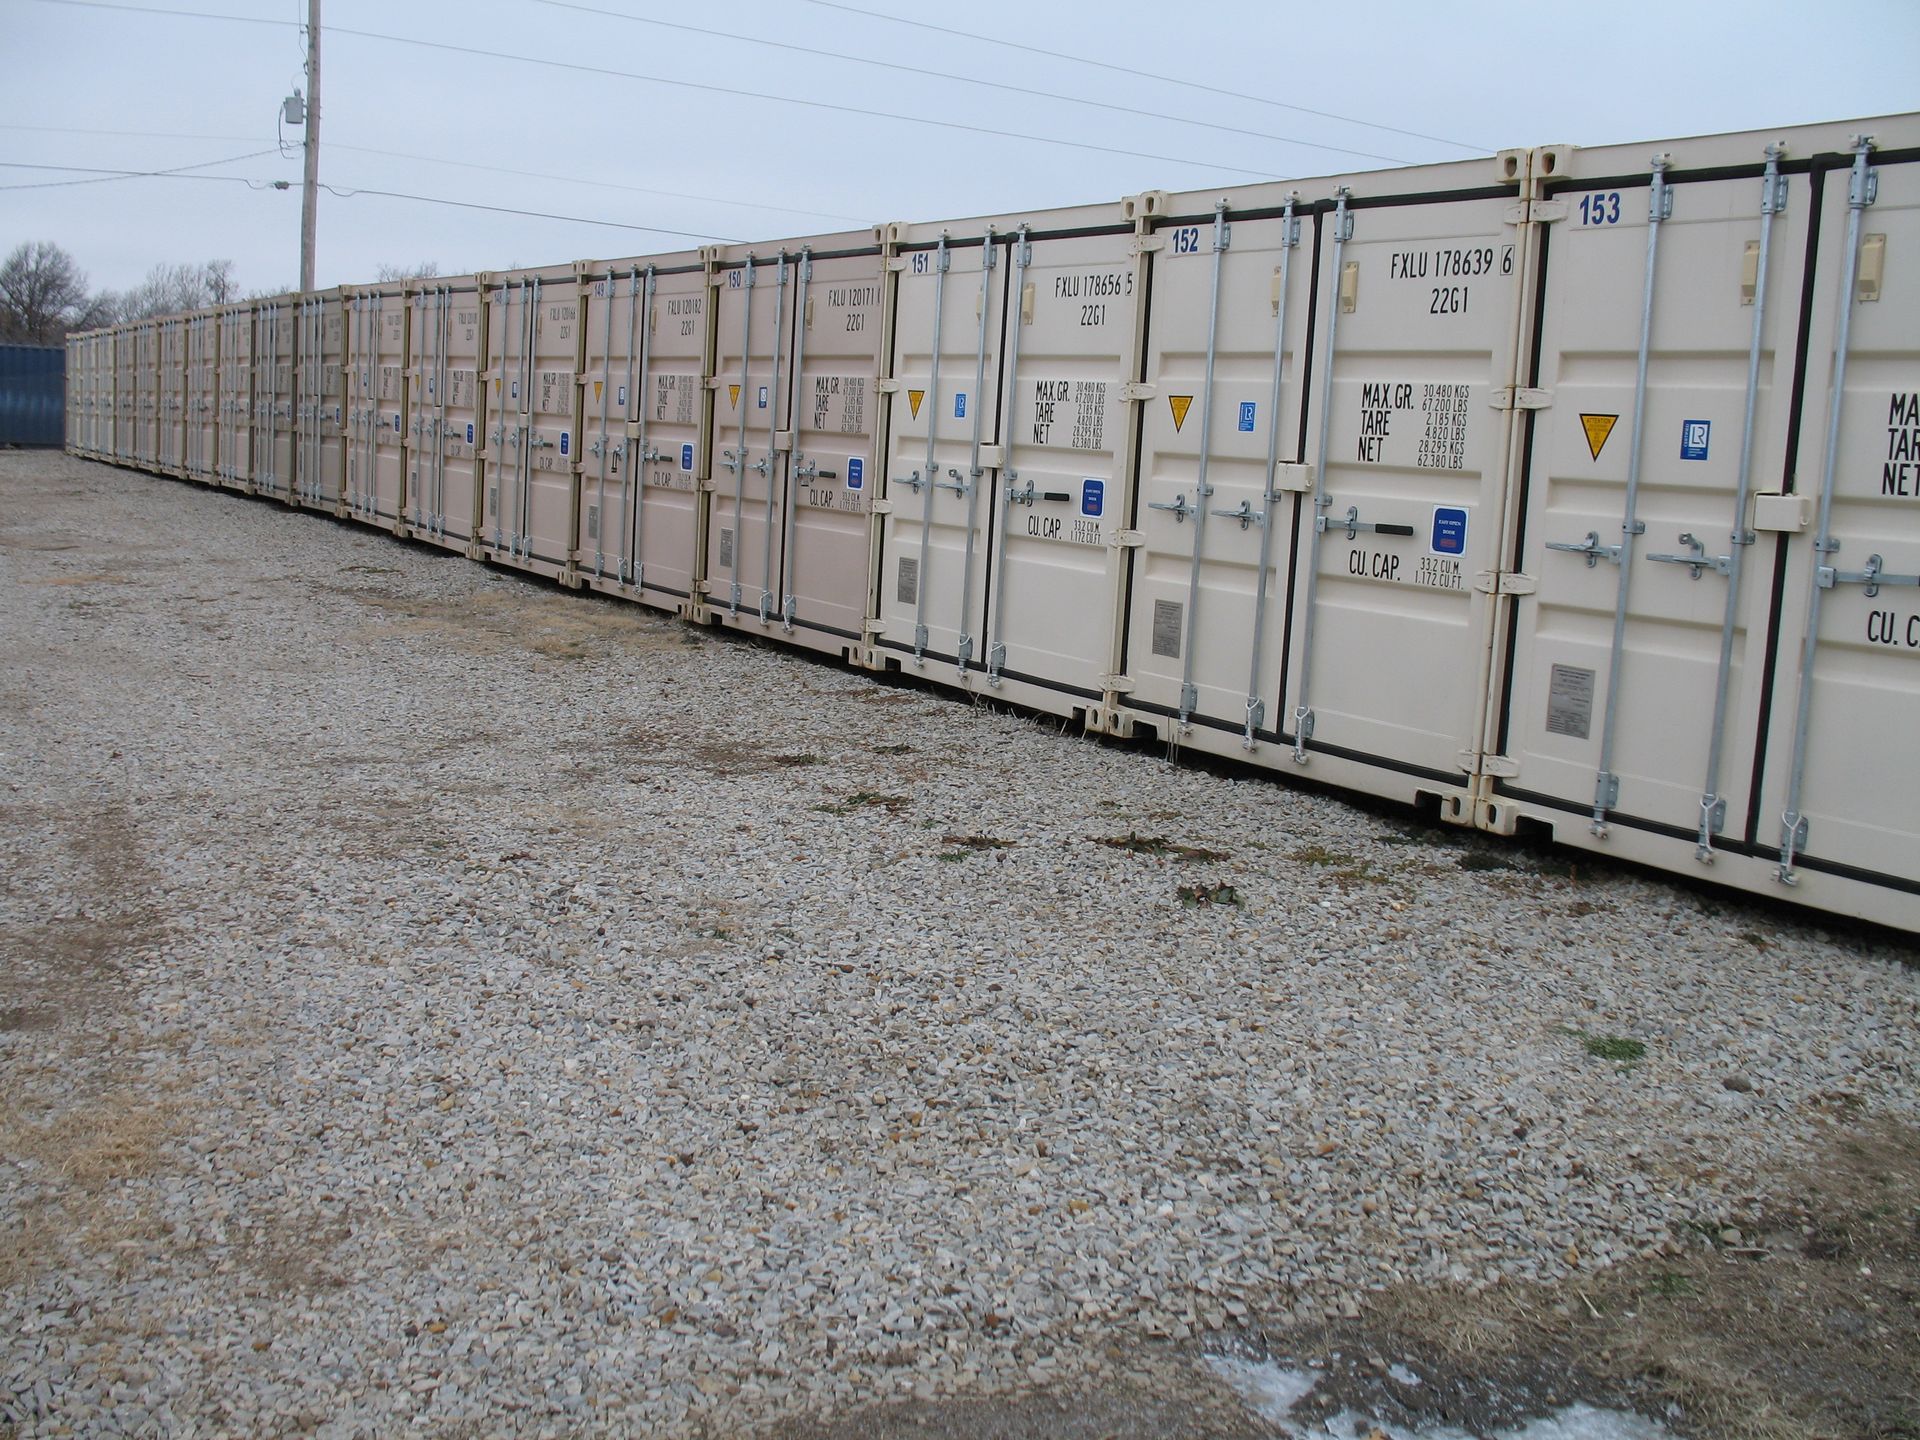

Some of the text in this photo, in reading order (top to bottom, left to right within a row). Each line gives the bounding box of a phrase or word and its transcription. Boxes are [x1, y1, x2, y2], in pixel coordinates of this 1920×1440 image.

[1580, 192, 1620, 225] 153
[1172, 228, 1198, 253] 152
[912, 254, 928, 273] 151
[1390, 247, 1512, 278] FXLU 178639 6
[729, 271, 741, 288] 150
[1055, 276, 1080, 297] FXLU
[1084, 274, 1121, 296] 178656
[828, 289, 845, 307] FXLU
[849, 288, 874, 306] 120171
[1430, 286, 1468, 314] 22G1
[846, 314, 864, 331] 22G1
[1081, 304, 1105, 326] 22G1
[1096, 382, 1106, 393] KGS
[1424, 385, 1452, 398] 30.480
[1454, 385, 1469, 398] KGS
[1095, 394, 1104, 404] LBS
[1422, 399, 1468, 412] 67.200 LBS
[814, 412, 826, 430] NET
[1036, 402, 1055, 423] TARE
[1361, 410, 1467, 436] TARE 2.185 KGS
[1033, 424, 1050, 444] NET
[1425, 427, 1465, 441] 4.820 LBS
[1358, 437, 1464, 462] NET 28.295 KGS
[1417, 454, 1463, 469] 62.380 LBS
[1028, 515, 1040, 536] CU.
[1043, 517, 1062, 540] CAP.
[1349, 550, 1368, 576] CU.
[1372, 553, 1400, 581] CAP.
[1420, 557, 1438, 572] 33.2
[1415, 570, 1437, 586] 1.172
[1867, 611, 1898, 645] CU.
